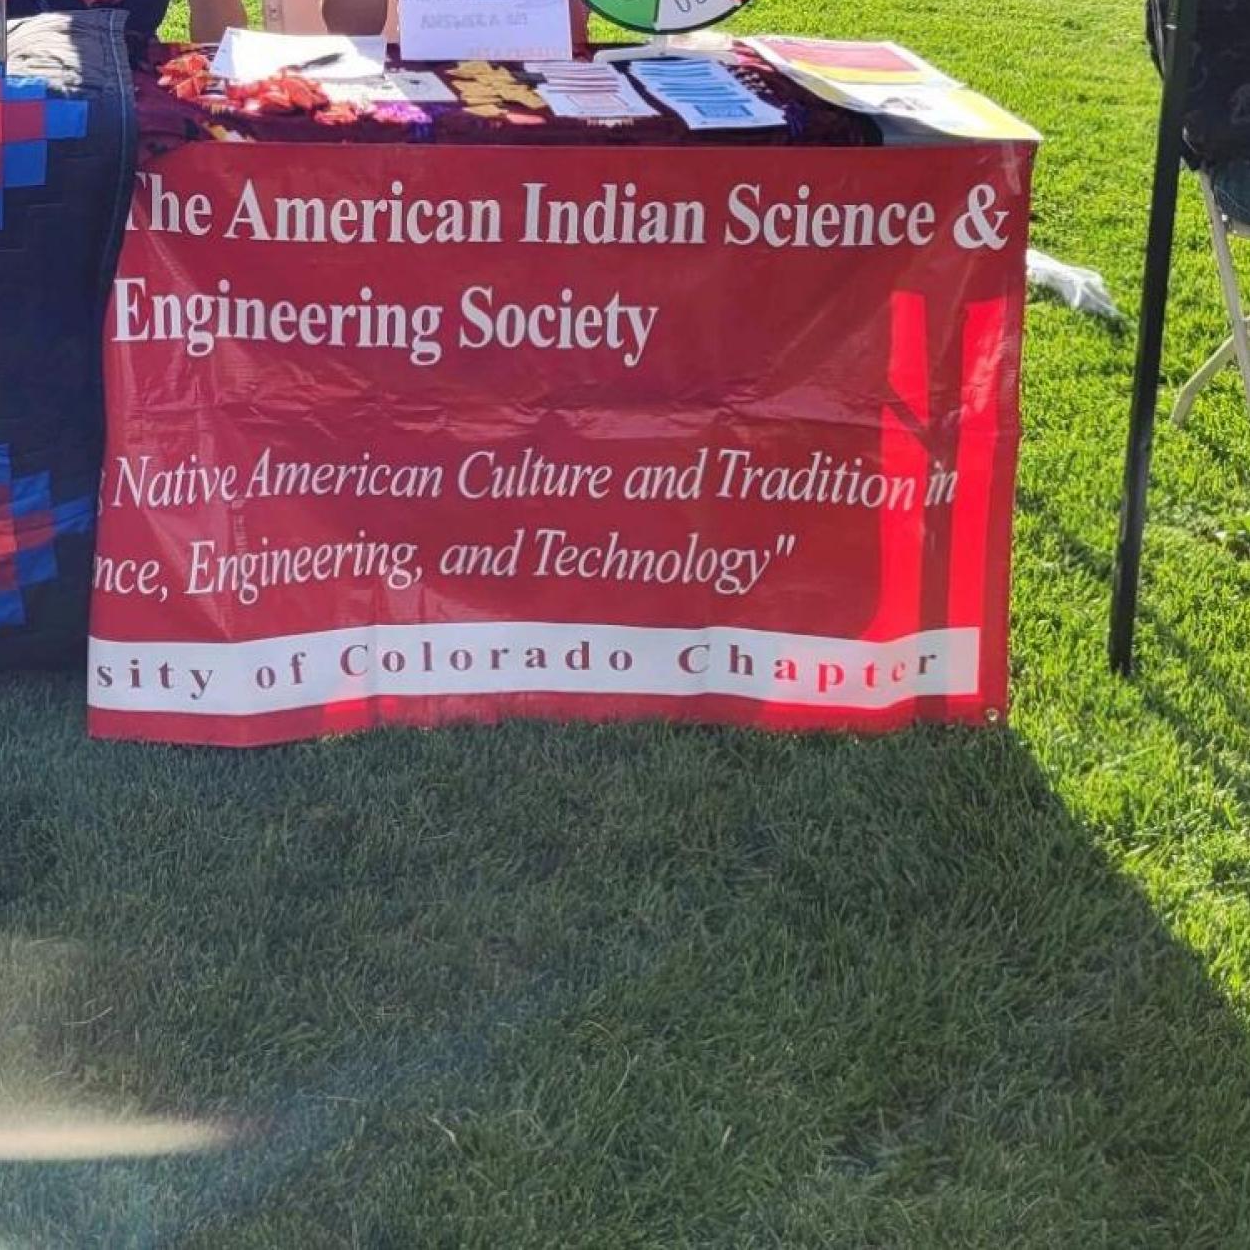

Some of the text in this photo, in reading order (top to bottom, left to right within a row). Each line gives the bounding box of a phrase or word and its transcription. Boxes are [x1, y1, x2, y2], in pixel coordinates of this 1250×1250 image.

[223, 178, 504, 244] American
[518, 181, 705, 245] Indian
[723, 183, 936, 249] Science
[953, 183, 1009, 251] &
[112, 277, 659, 367] Engineering Society
[111, 454, 238, 509] Native
[246, 447, 443, 500] American
[458, 447, 612, 501] Culture
[623, 448, 709, 501] and
[714, 448, 916, 511] Tradition
[924, 460, 958, 506] in
[95, 528, 797, 605] nce, Engineering, and Technology"
[97, 641, 938, 700] sity of Colorado Chapter
